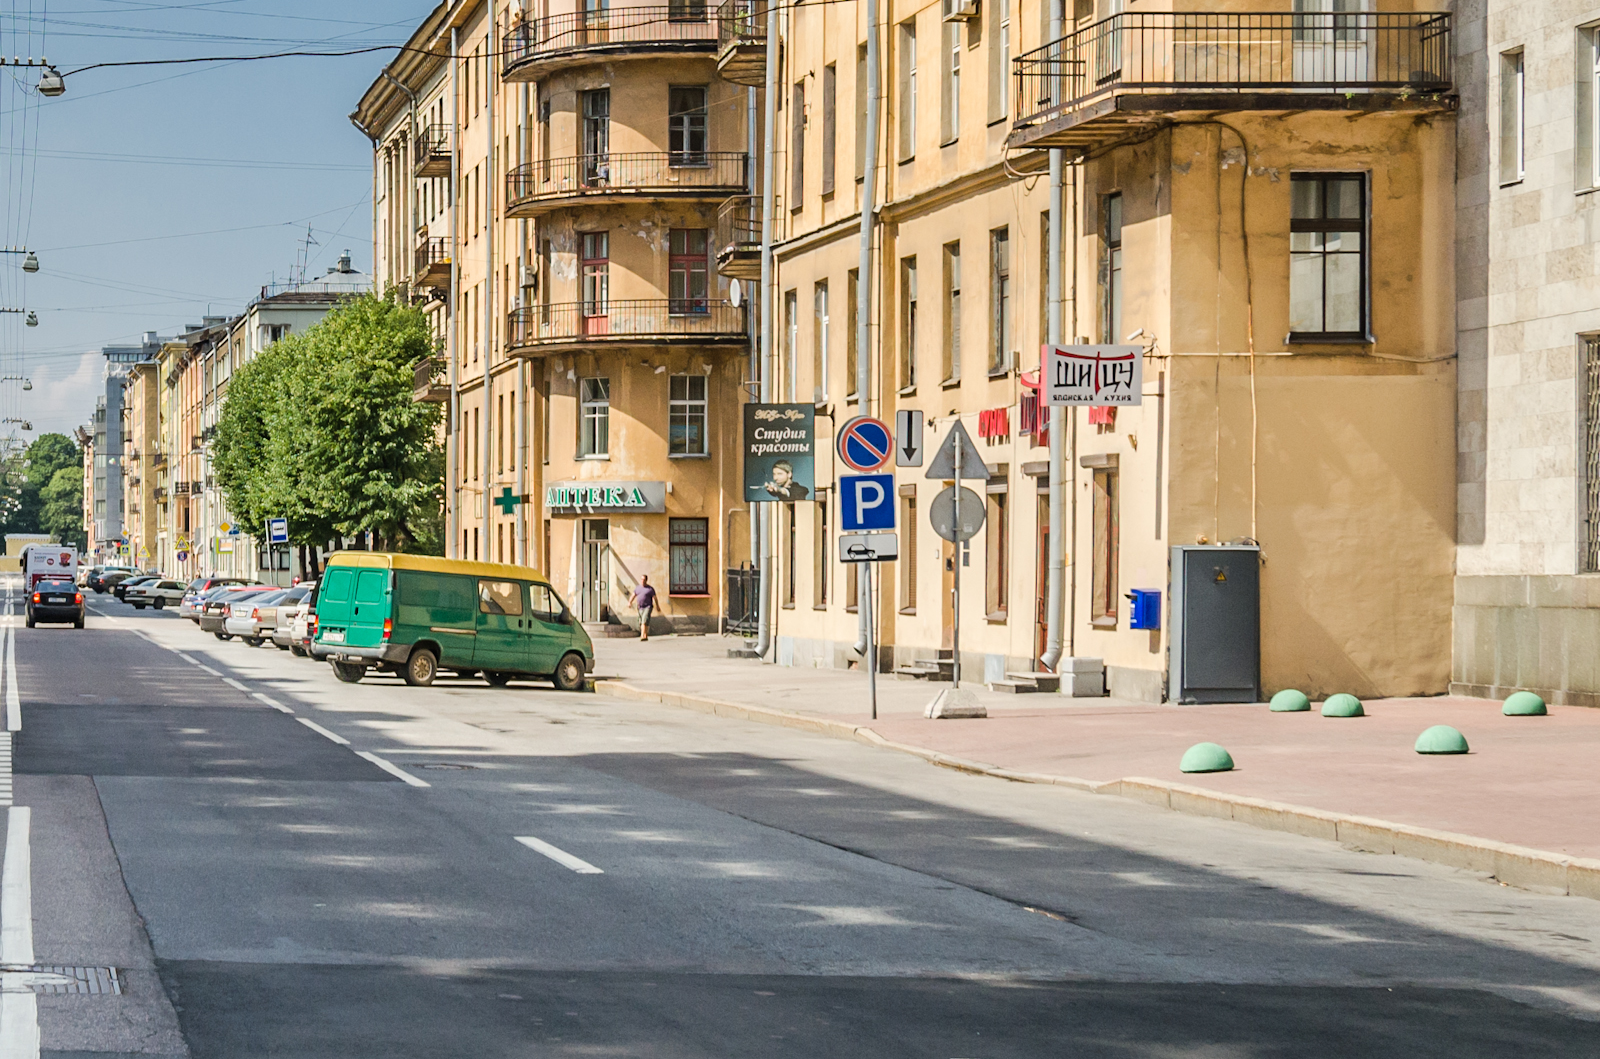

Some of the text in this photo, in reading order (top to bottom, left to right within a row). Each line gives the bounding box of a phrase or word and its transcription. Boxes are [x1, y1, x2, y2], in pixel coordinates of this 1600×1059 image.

[1054, 348, 1135, 395] ШИТЦУ
[1053, 394, 1132, 402] ЯПОНСКАЯ КУХНЯ
[754, 426, 807, 443] Студия
[751, 443, 810, 457] красоты
[545, 486, 646, 507] АПТЕКА
[855, 480, 885, 525] P
